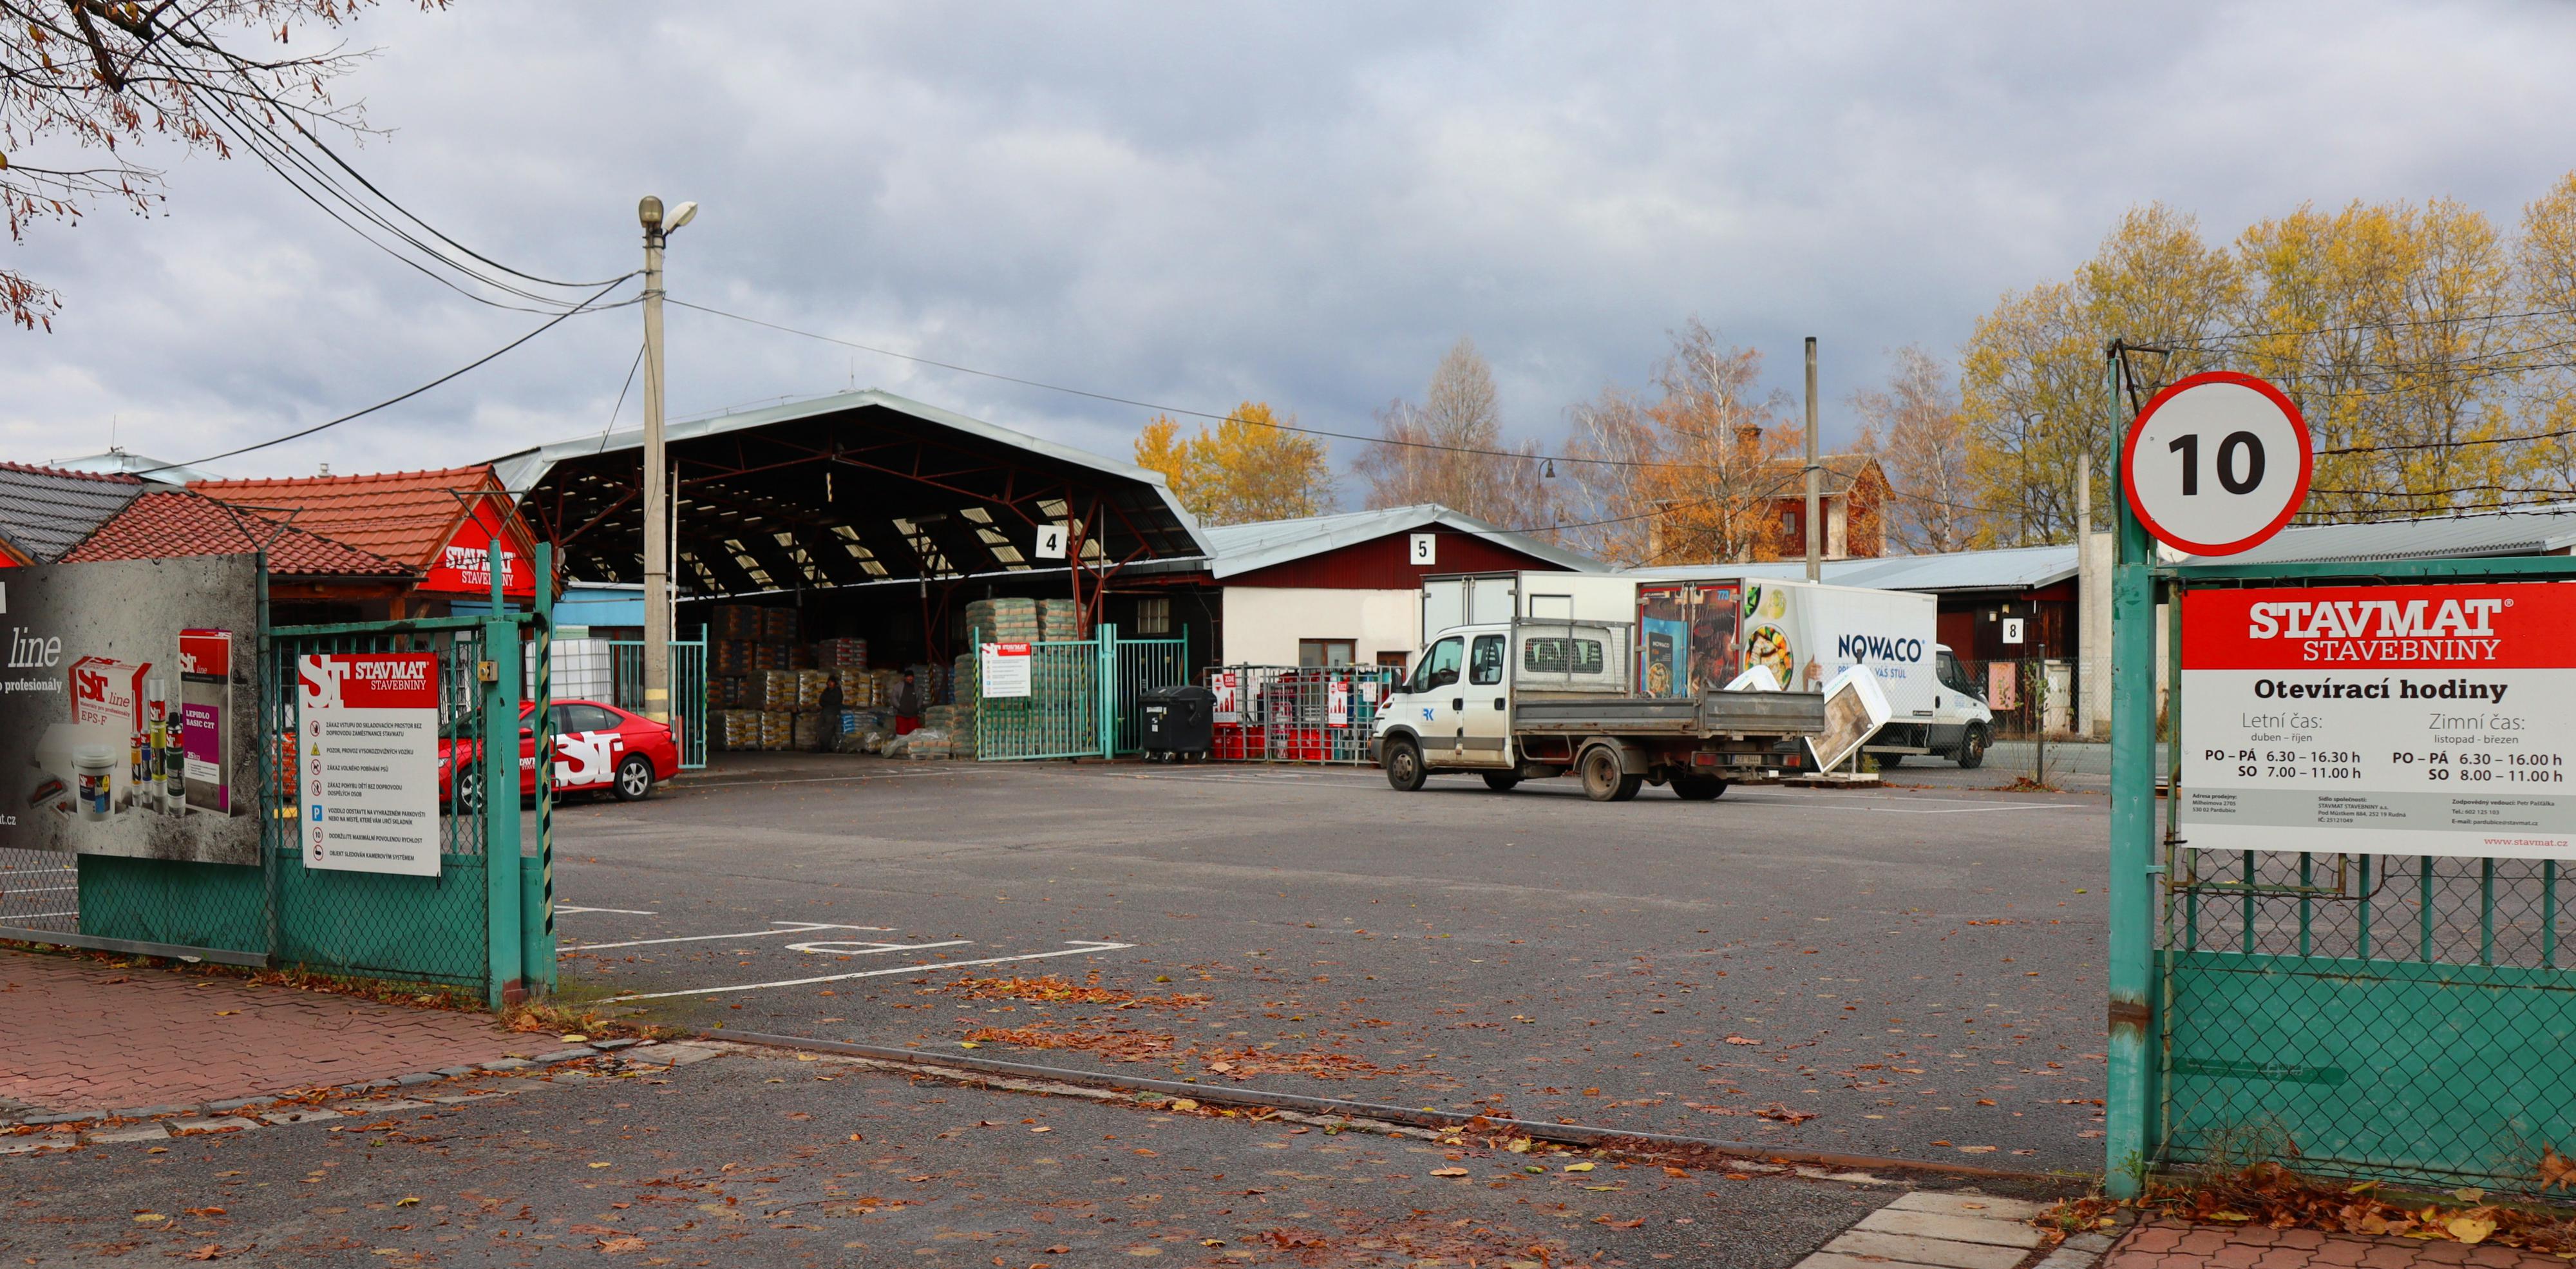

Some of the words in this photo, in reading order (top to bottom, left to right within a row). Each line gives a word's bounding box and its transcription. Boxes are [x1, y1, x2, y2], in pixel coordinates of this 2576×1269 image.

[2168, 431, 2266, 496] 10
[1046, 533, 1057, 551] 4
[1419, 540, 1427, 558] 5
[1717, 589, 1730, 600] 773
[2009, 624, 2017, 638] 8
[8, 627, 62, 668] line
[1652, 640, 1671, 649] NOWACO
[1838, 634, 1922, 663] NOWACO
[2303, 639, 2501, 662] STAVEBNINY
[355, 661, 427, 680] STAVMAT
[1875, 665, 1888, 678] VÁŠ
[5, 676, 62, 694] profesionály
[77, 669, 108, 703] ST
[108, 691, 130, 708] line
[371, 680, 426, 691] STAVEBNINY
[2254, 678, 2390, 700] Otevírací
[2400, 678, 2508, 704] hodiny
[81, 710, 108, 726] EPS-F
[185, 709, 210, 720] LEPIDLO
[2242, 712, 2285, 729] Letní
[2290, 712, 2322, 729] čas:
[2429, 713, 2484, 730] Zimní
[2490, 713, 2525, 730] čas:
[185, 718, 203, 728] BASIC
[204, 720, 215, 730] C2T
[2251, 733, 2282, 741] duben
[2291, 732, 2313, 743] říjen
[2434, 734, 2475, 745] listopad
[2483, 734, 2519, 744] březen
[2205, 750, 2225, 761] PO
[2239, 747, 2257, 761] PÁ
[2266, 750, 2296, 763] 6.30
[2311, 751, 2349, 763] 16.30
[2351, 750, 2361, 763] h
[2392, 752, 2414, 764] PO
[2429, 750, 2449, 765] PÁ
[2459, 753, 2491, 765] 6.30
[2508, 754, 2549, 766] 16.00
[2552, 754, 2562, 766] h
[2238, 765, 2258, 778] SO
[2267, 767, 2297, 778] 7.00
[2311, 767, 2349, 779] 11.00
[2353, 767, 2362, 779] h
[2428, 768, 2450, 781] SO
[2459, 770, 2492, 781] 8.00
[2509, 770, 2550, 782] 11.00
[2553, 770, 2563, 783] h
[2483, 837, 2568, 847] www.stavmat.cz
